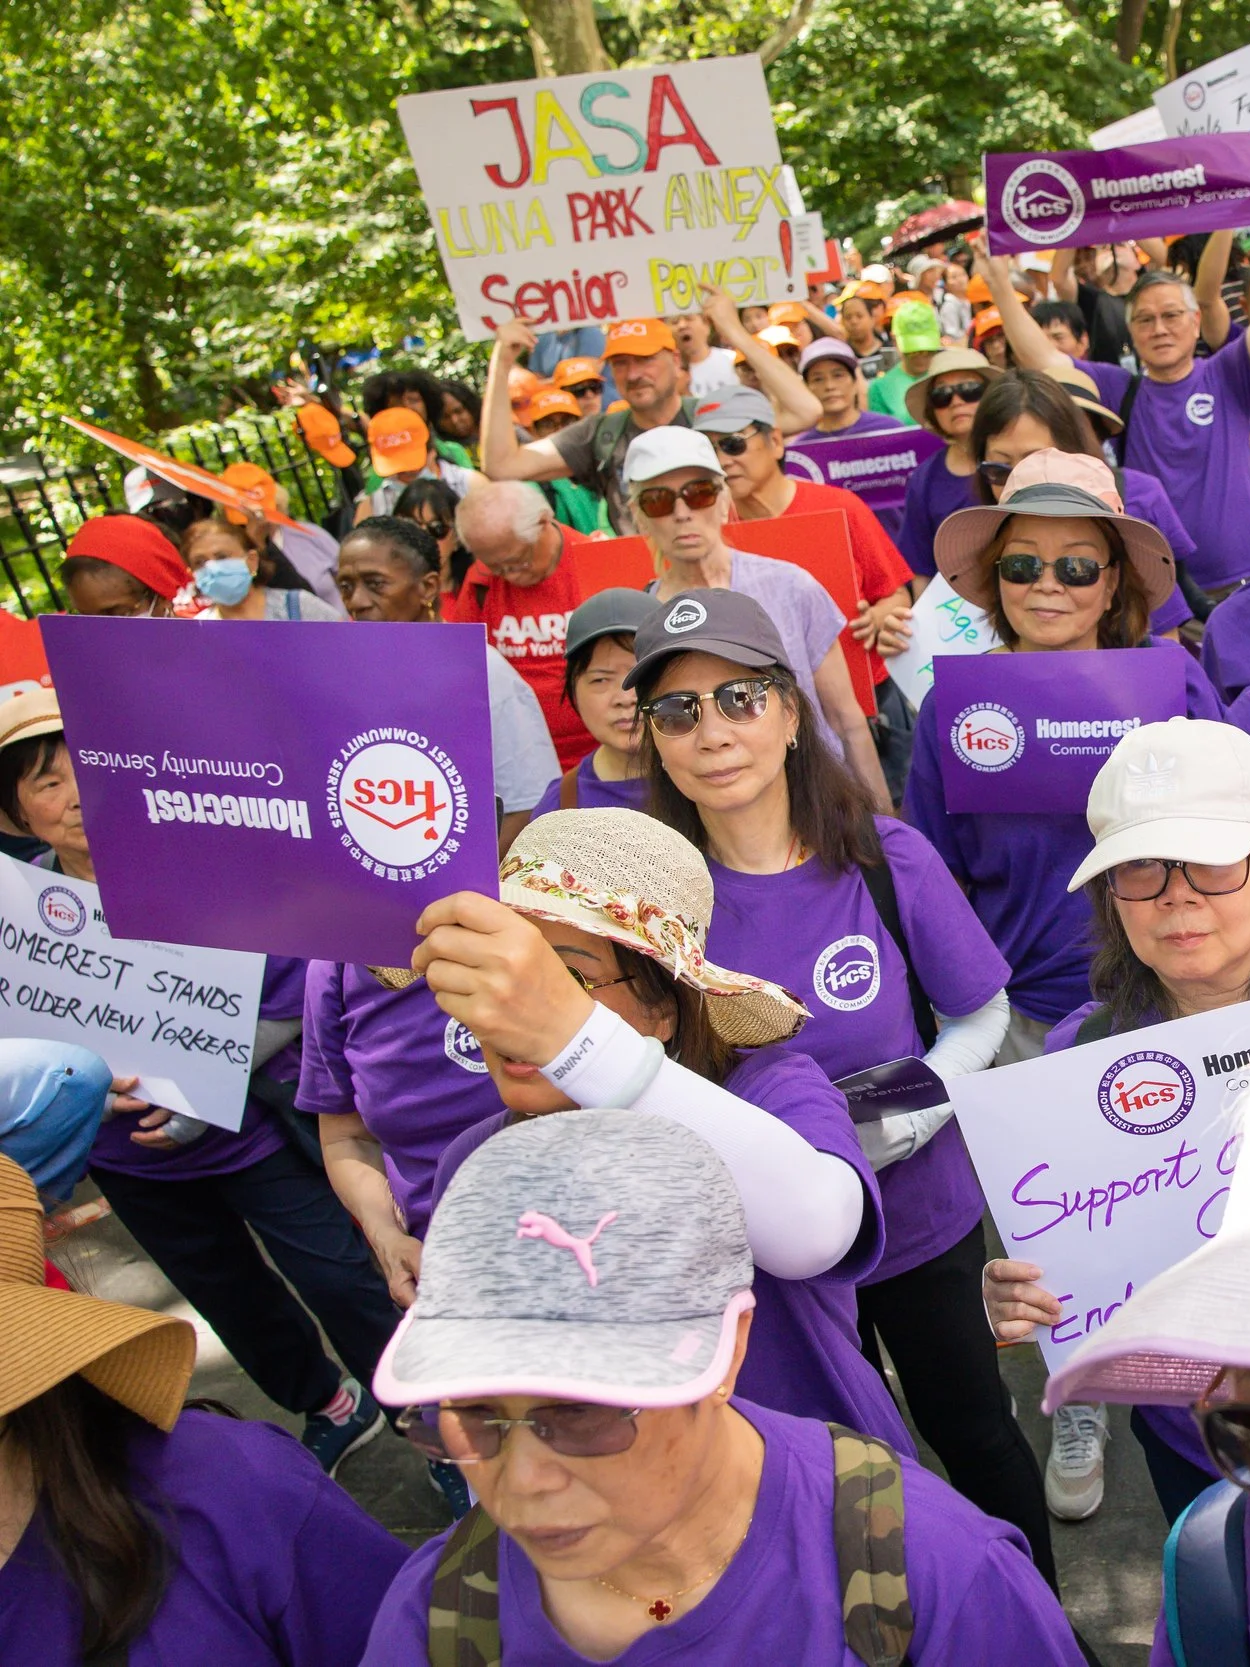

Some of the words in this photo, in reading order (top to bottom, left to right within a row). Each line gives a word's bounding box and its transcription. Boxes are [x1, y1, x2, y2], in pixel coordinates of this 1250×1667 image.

[469, 74, 721, 189] JASA
[1091, 164, 1206, 199] Homecrest
[436, 198, 555, 258] LUNA
[567, 186, 654, 242] PARK
[664, 164, 790, 242] ANNEX
[1109, 194, 1191, 214] Community
[827, 450, 918, 480] Homecrest
[935, 596, 978, 645] Age
[79, 749, 155, 778] Services
[340, 727, 429, 761] COMMUNITY
[1050, 743, 1117, 755] Communi
[162, 751, 284, 786] Community
[428, 745, 469, 834] HOMECREST
[142, 788, 312, 840] Homecrest
[326, 759, 344, 829] SERVICES
[354, 778, 435, 821] HCS
[146, 971, 243, 1017] STANDS
[16, 984, 86, 1027] OLDER
[85, 1003, 144, 1035] NEW
[151, 1010, 250, 1073] YORKERS.
[552, 1036, 594, 1080] LI-NING
[866, 1081, 933, 1098] Services
[1100, 1091, 1132, 1131] HOMECREST
[1133, 1107, 1187, 1134] COMMUNITY
[1179, 1069, 1194, 1106] SERVICES
[1119, 1087, 1176, 1113] HCS
[1011, 1139, 1202, 1242] Support
